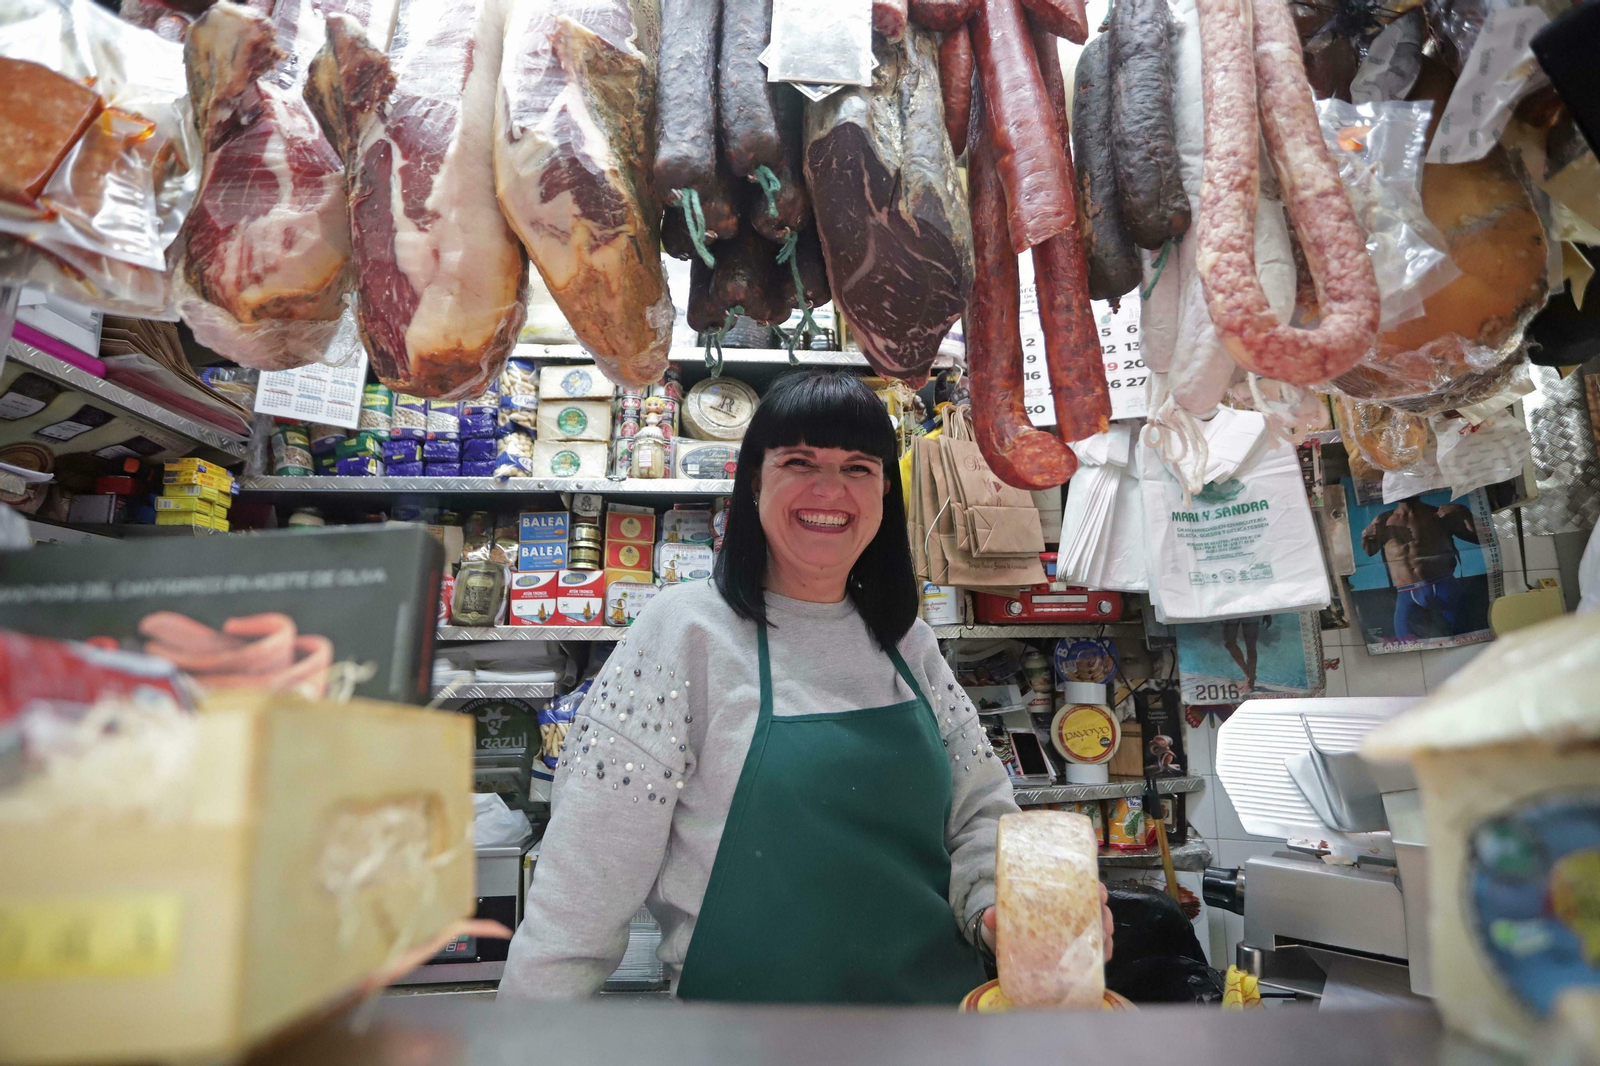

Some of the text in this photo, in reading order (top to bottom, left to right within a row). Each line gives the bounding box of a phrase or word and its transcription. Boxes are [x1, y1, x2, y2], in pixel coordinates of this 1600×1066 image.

[1101, 325, 1138, 337] 5 6
[1025, 338, 1036, 347] 2
[1101, 345, 1118, 355] 12
[1026, 354, 1037, 364] 9
[1123, 360, 1146, 370] 20
[1024, 370, 1041, 381] 16
[1126, 376, 1148, 387] 27
[1024, 388, 1045, 398] 23
[1171, 499, 1270, 522] MARI Y SANDRA
[522, 516, 565, 528] BALEA
[521, 545, 563, 557] BALEA
[1371, 640, 1425, 654] September
[1195, 683, 1240, 701] 2016
[480, 731, 528, 750] gazul
